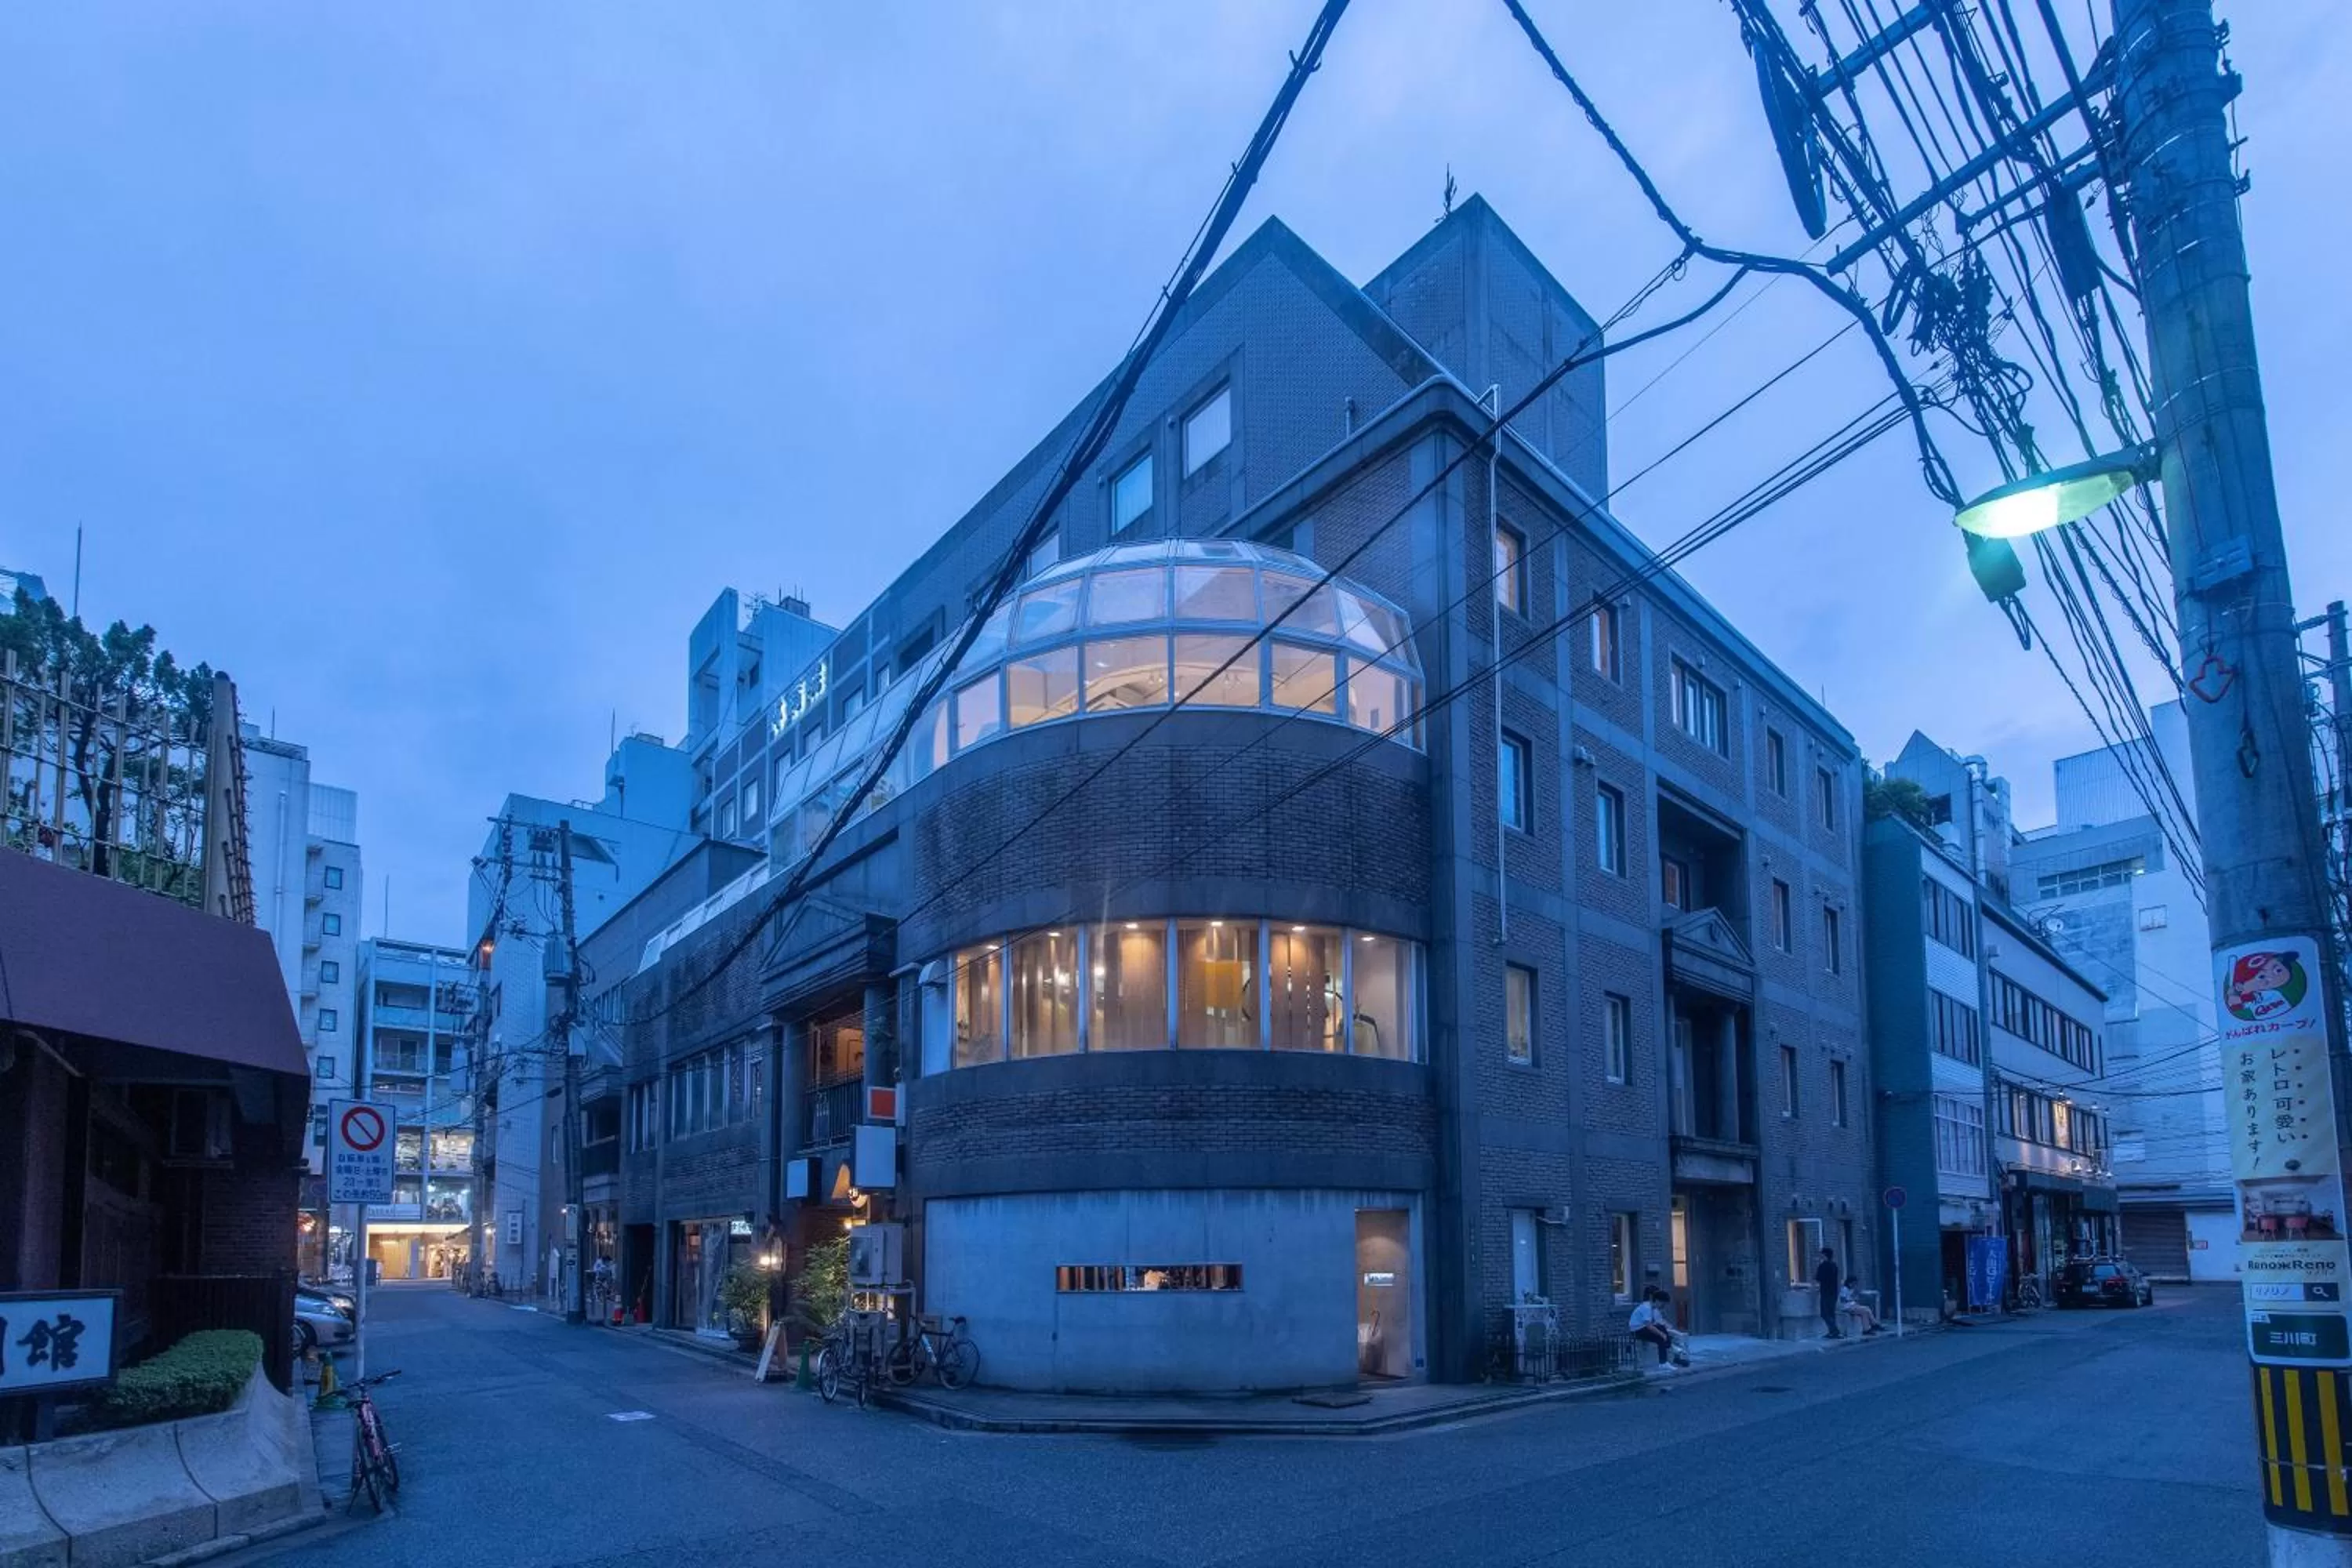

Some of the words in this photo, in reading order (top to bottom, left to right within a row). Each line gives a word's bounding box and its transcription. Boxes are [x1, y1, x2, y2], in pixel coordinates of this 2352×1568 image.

[2271, 1048, 2296, 1144] レトロ可愛い
[0, 1314, 86, 1376] 館
[2270, 1332, 2317, 1345] 三川町
